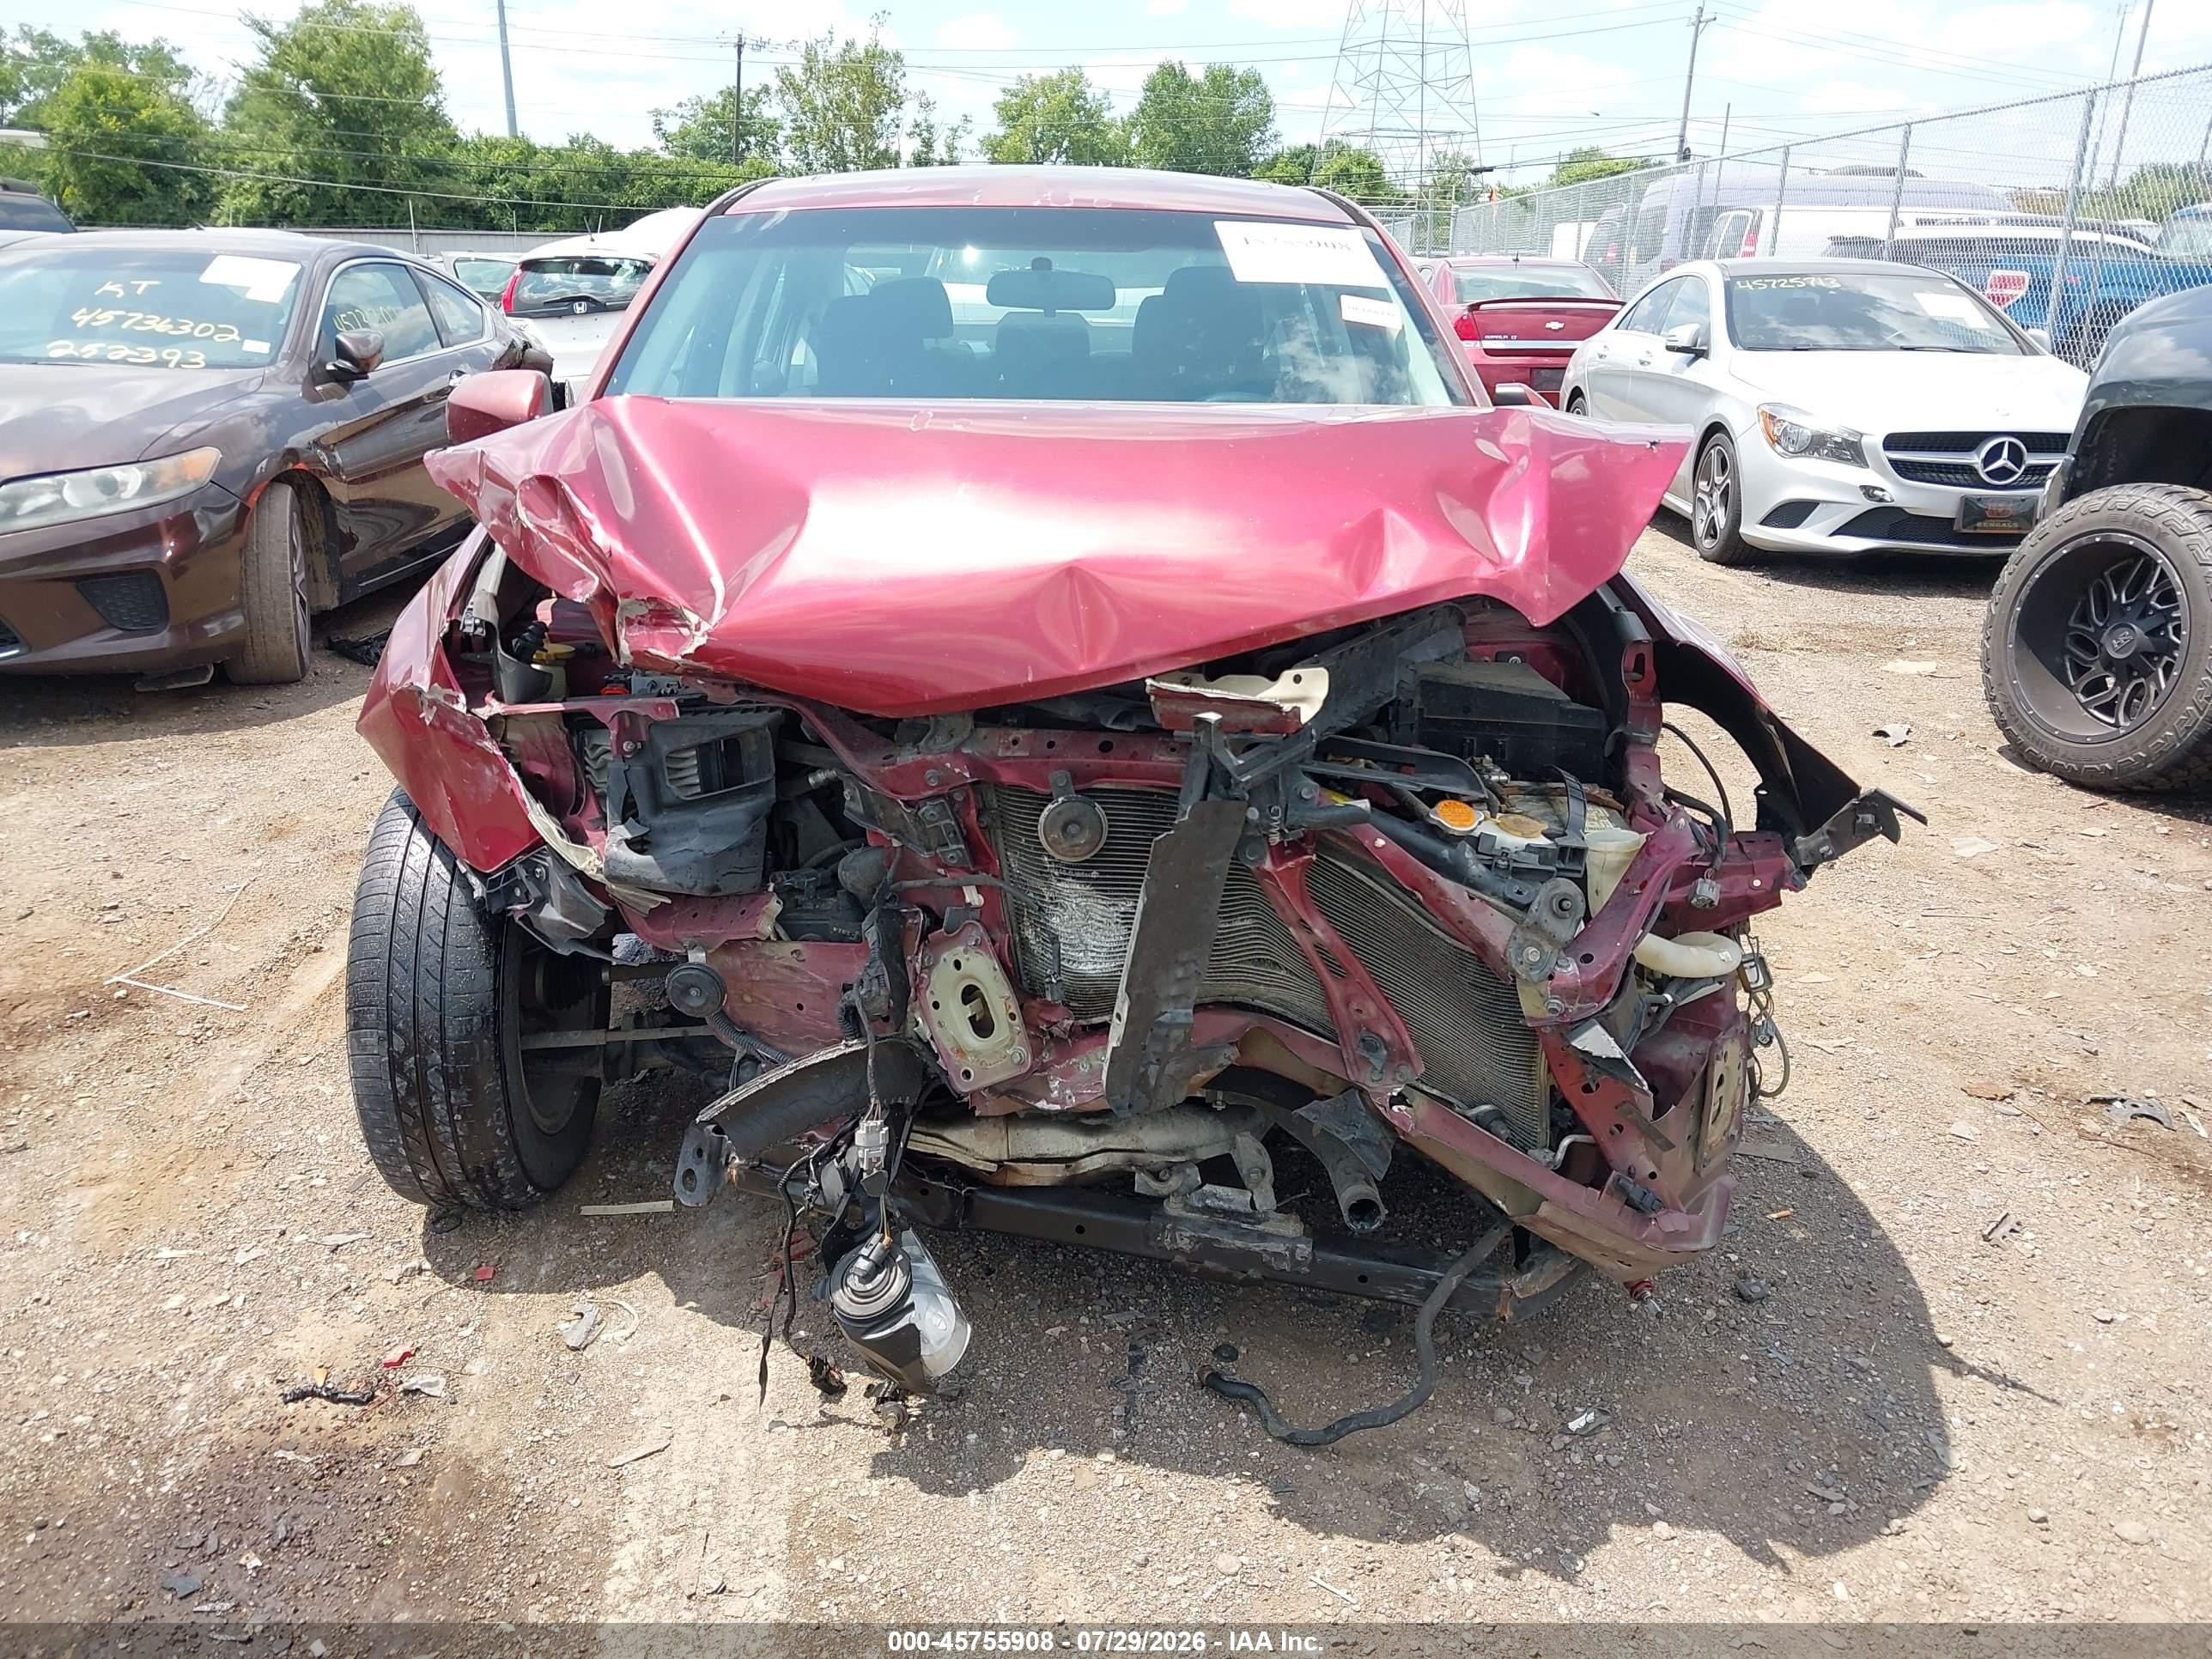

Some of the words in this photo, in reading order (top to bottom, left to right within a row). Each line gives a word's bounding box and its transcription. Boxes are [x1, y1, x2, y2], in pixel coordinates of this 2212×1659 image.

[1735, 276, 1842, 290] 45725713
[71, 307, 241, 343] 45736302
[46, 340, 206, 369] 252393
